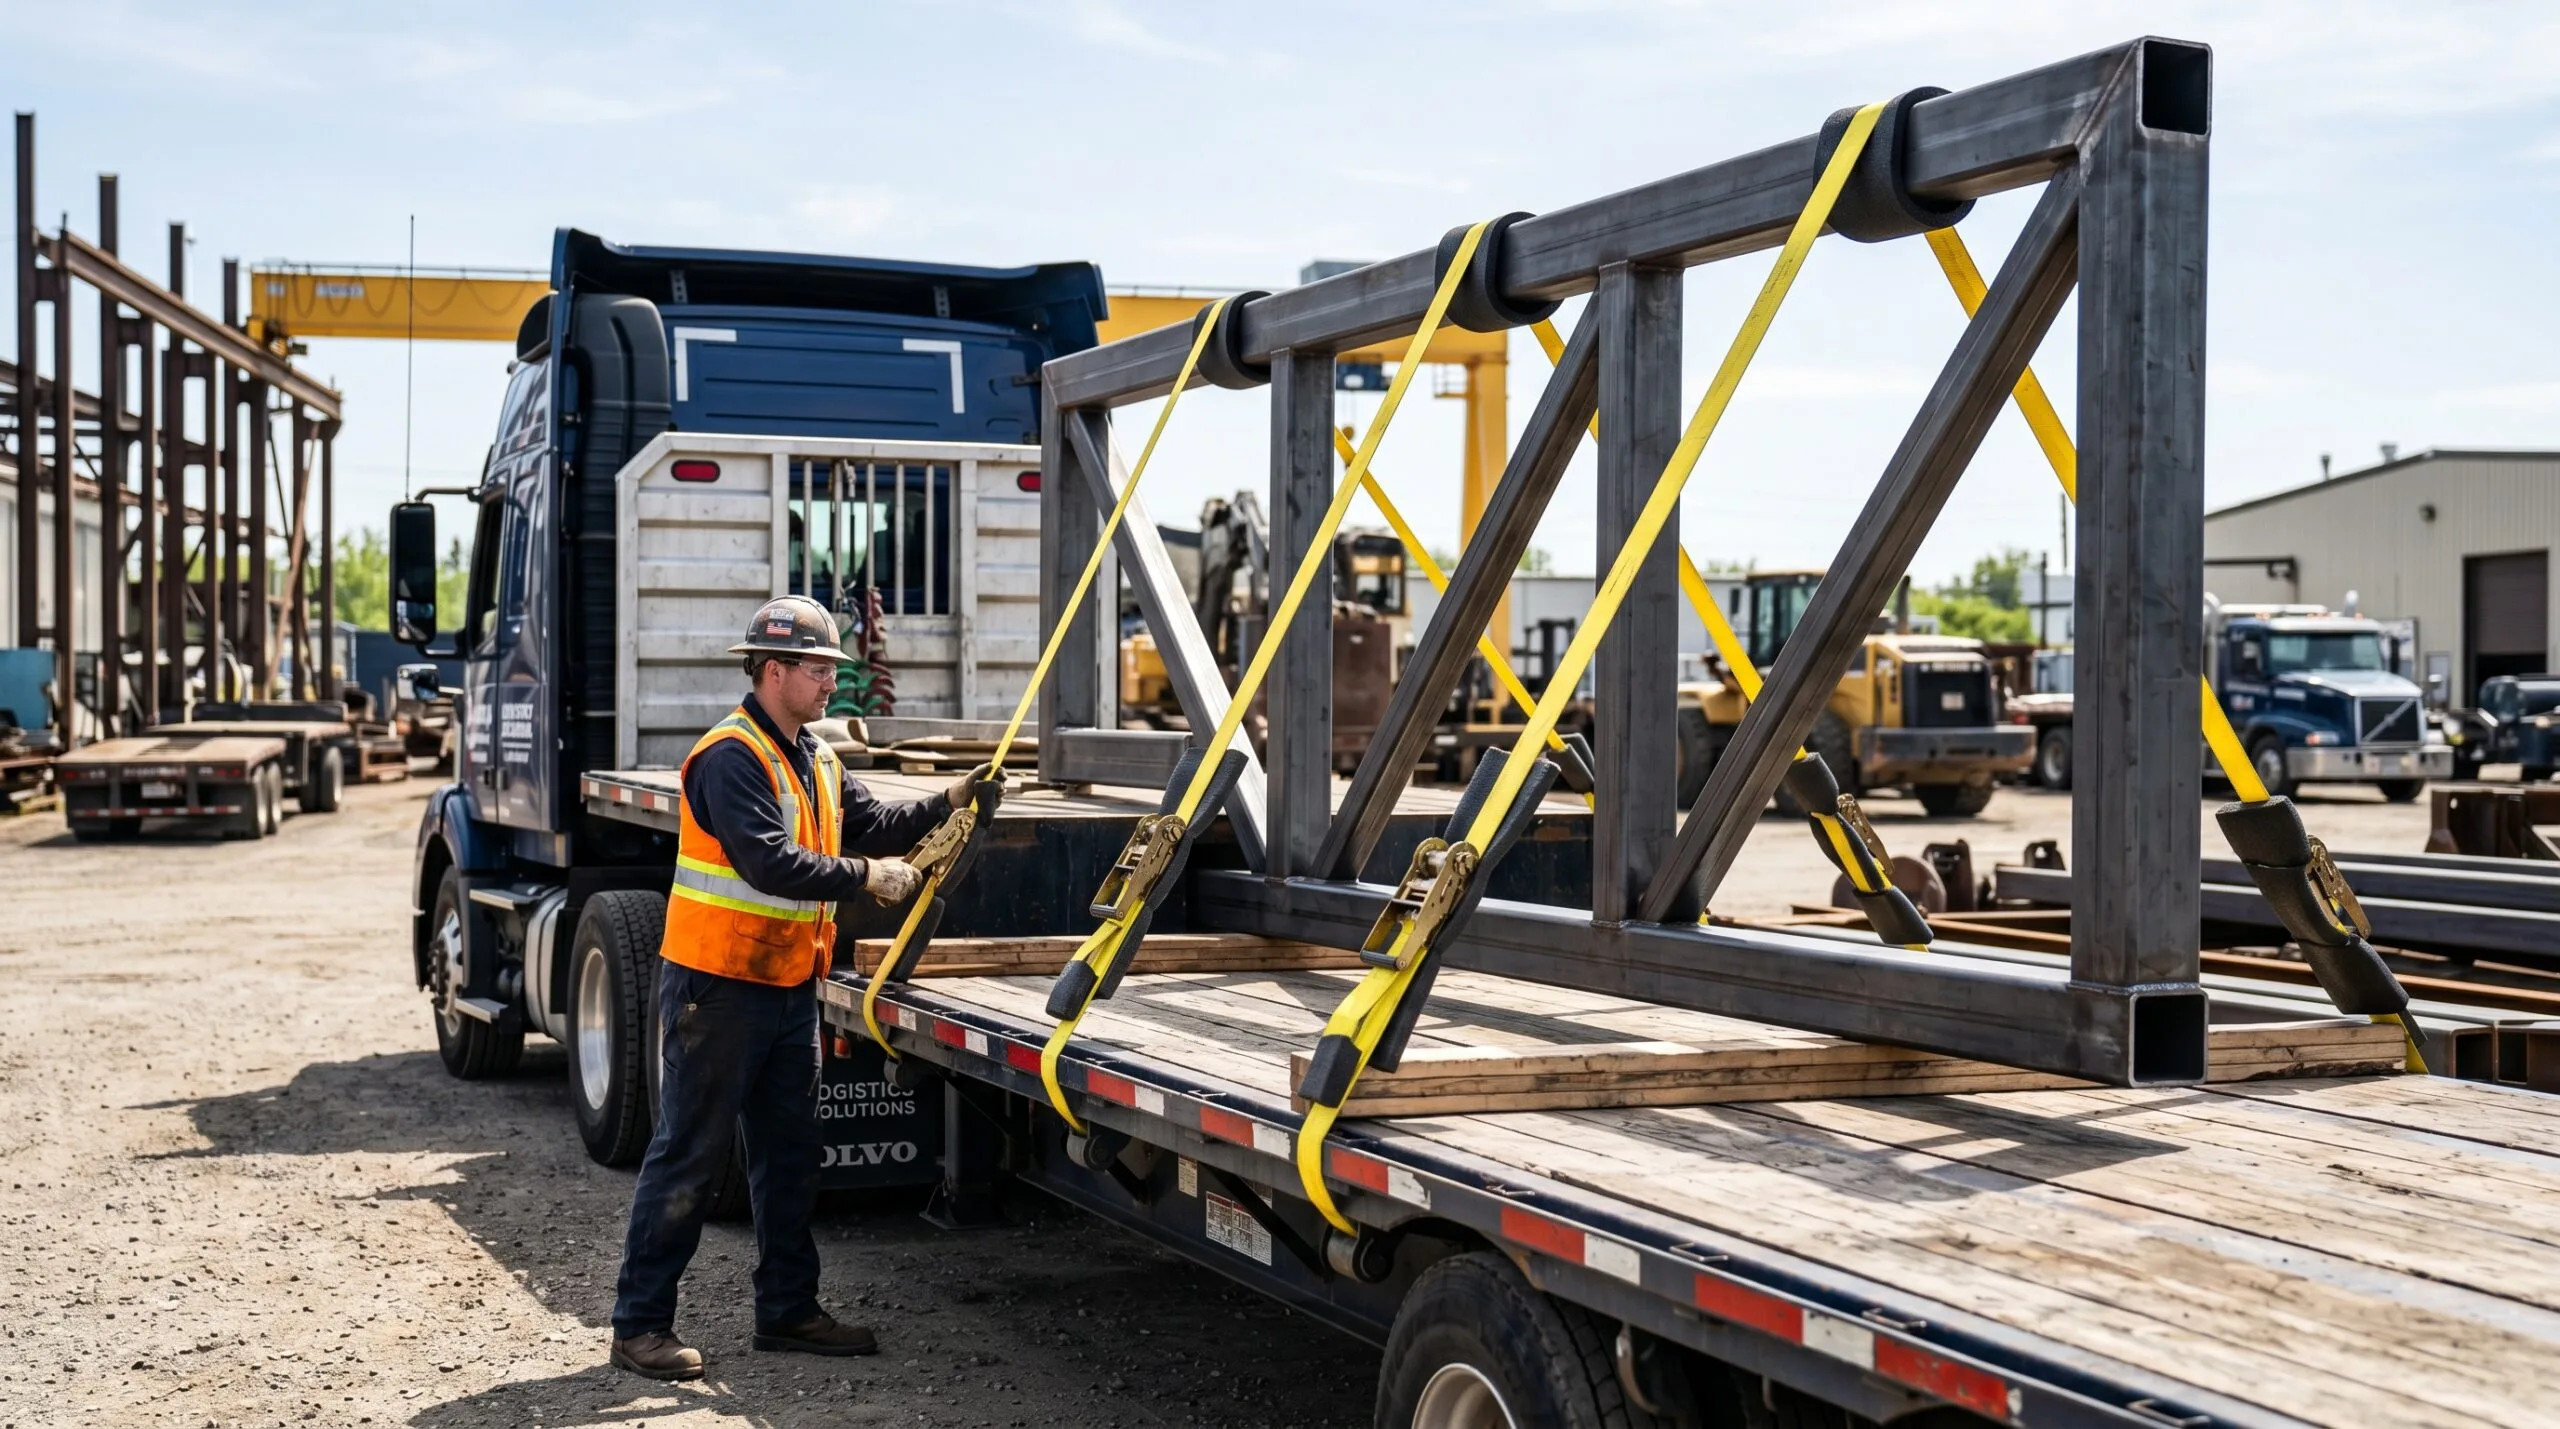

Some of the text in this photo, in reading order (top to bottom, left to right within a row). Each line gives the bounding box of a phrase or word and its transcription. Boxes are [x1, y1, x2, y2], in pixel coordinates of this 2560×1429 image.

[819, 1081, 914, 1101] OGISTIC
[819, 1100, 916, 1119] OLUTIONS
[820, 1141, 918, 1168] OLVO
